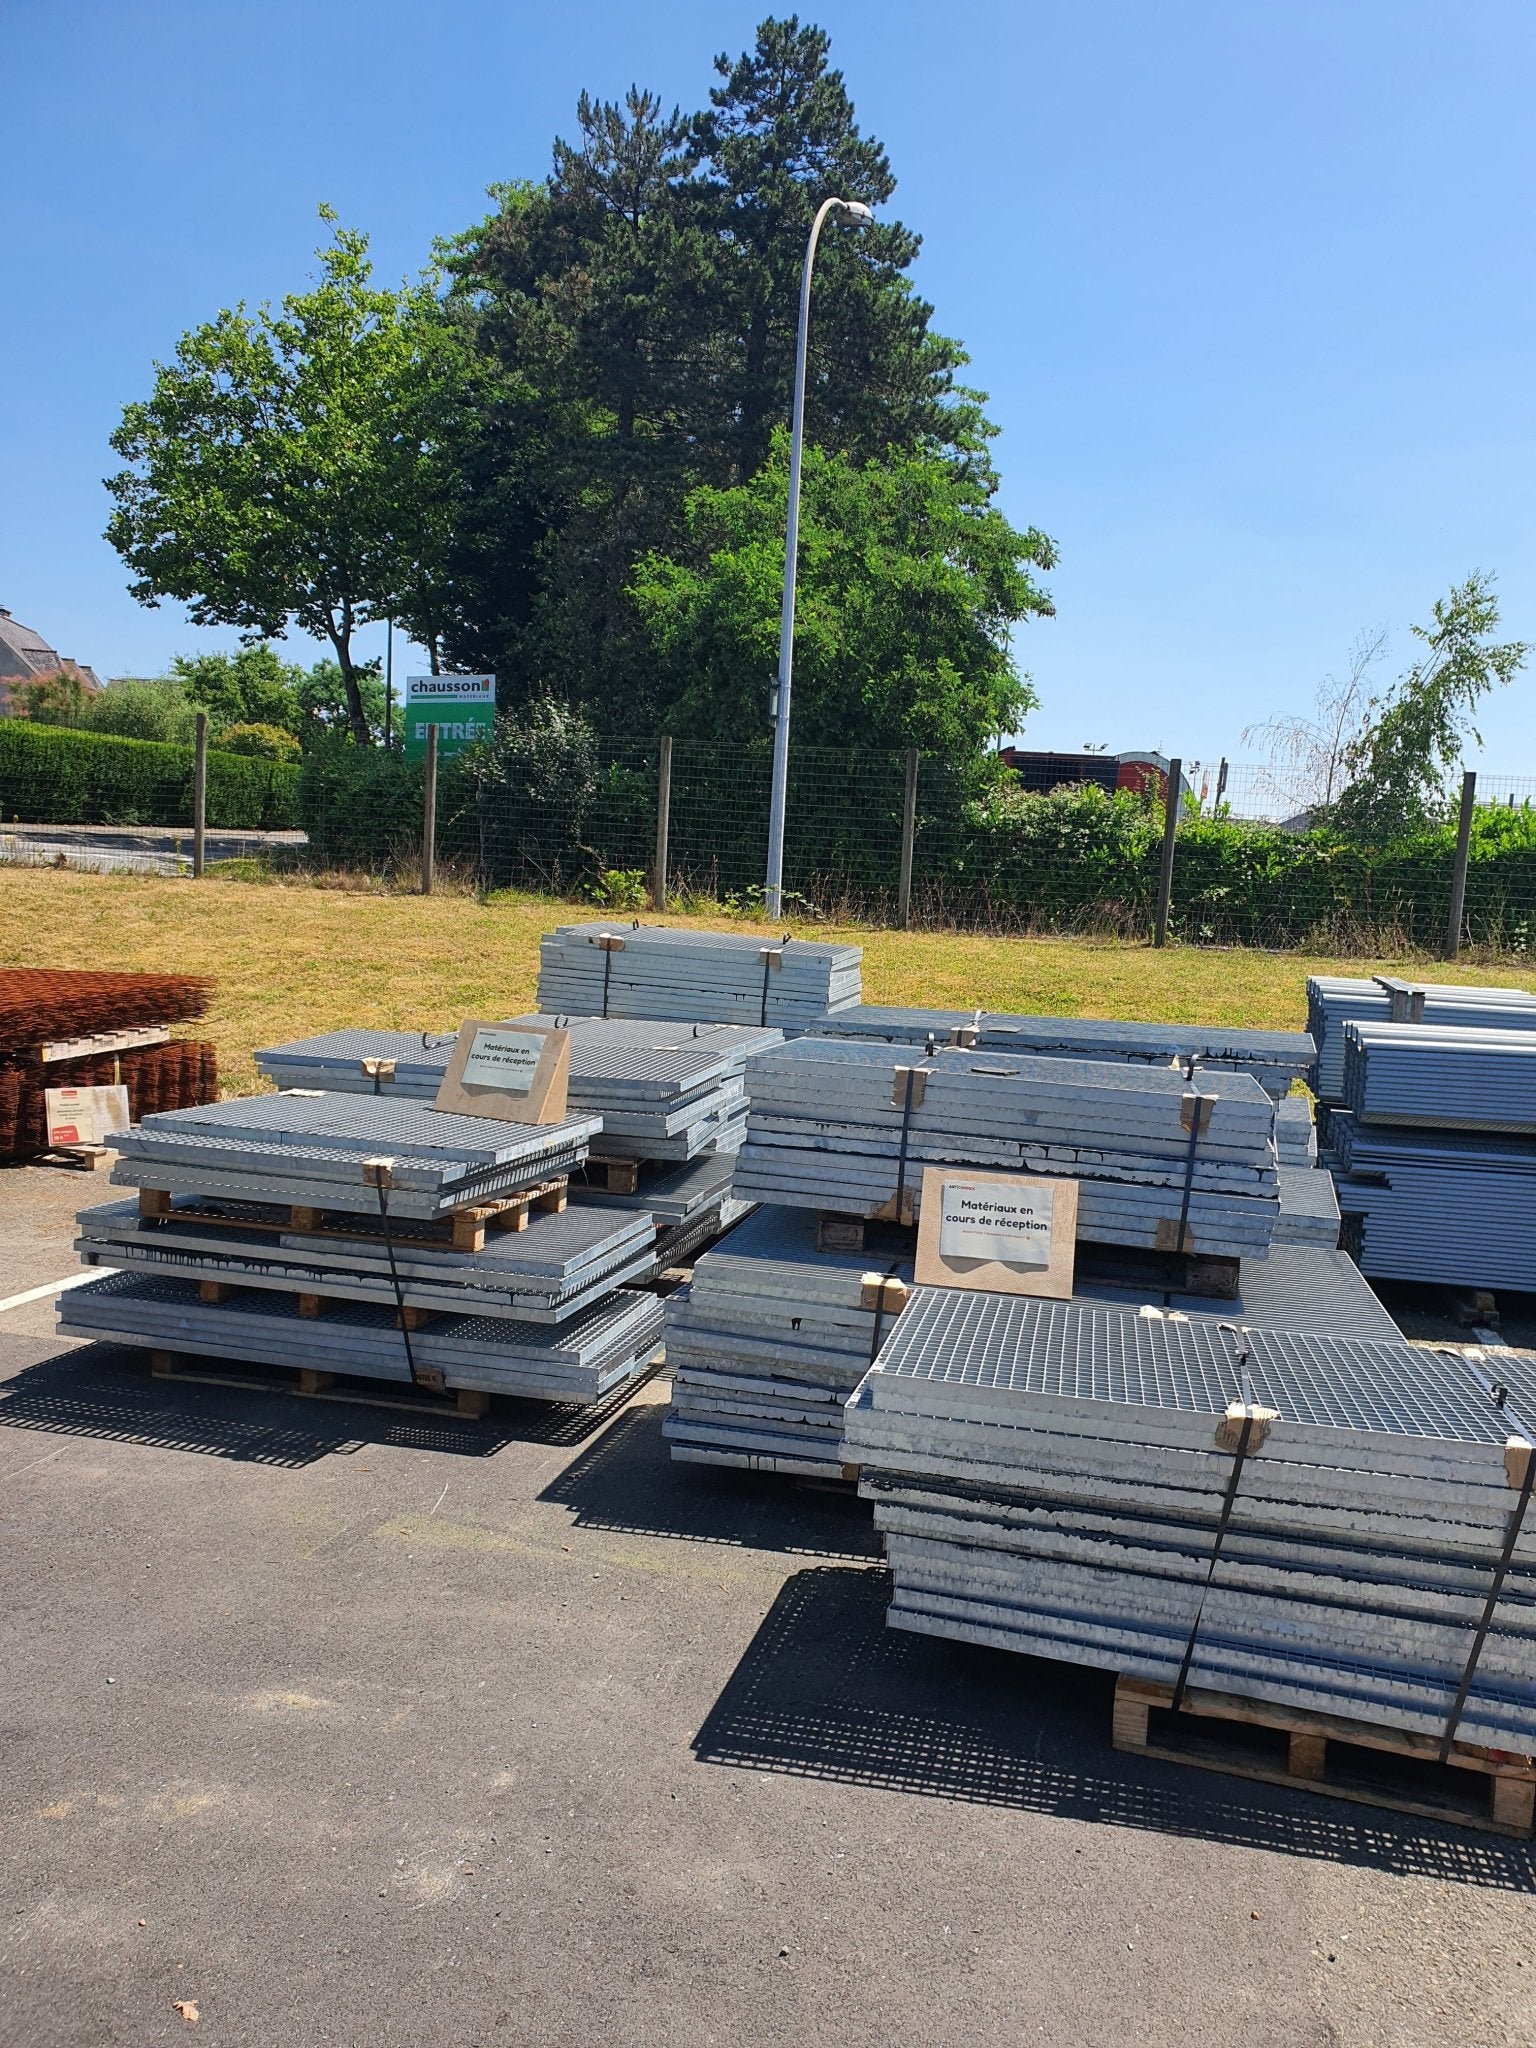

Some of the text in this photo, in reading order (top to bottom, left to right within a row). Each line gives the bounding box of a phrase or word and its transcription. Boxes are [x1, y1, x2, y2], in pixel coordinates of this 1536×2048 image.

[411, 680, 480, 693] chausson
[483, 1043, 519, 1053] Matériaux
[471, 1053, 491, 1061] cours
[502, 1056, 536, 1066] réception
[961, 1199, 1034, 1215] Matériaux en
[946, 1215, 1048, 1231] cours de réception
